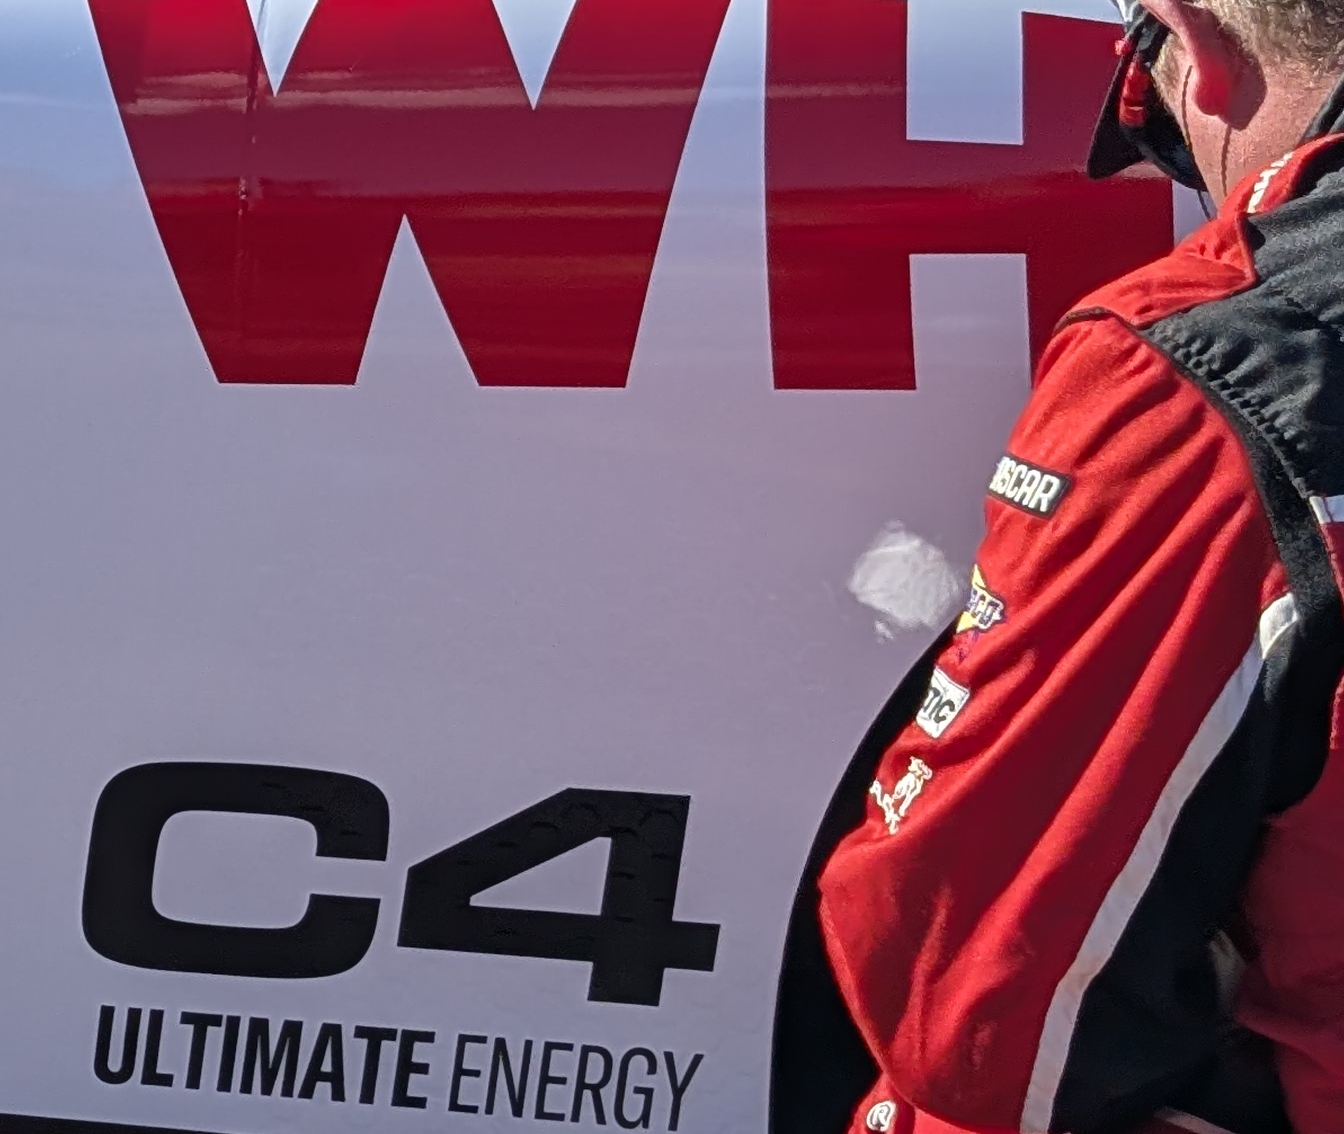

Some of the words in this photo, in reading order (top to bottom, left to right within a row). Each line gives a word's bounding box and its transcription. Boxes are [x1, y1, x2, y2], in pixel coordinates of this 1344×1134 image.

[82, 761, 721, 1008] C4
[93, 1004, 436, 1110] ULTIMATE
[447, 1033, 705, 1133] ENERGY
